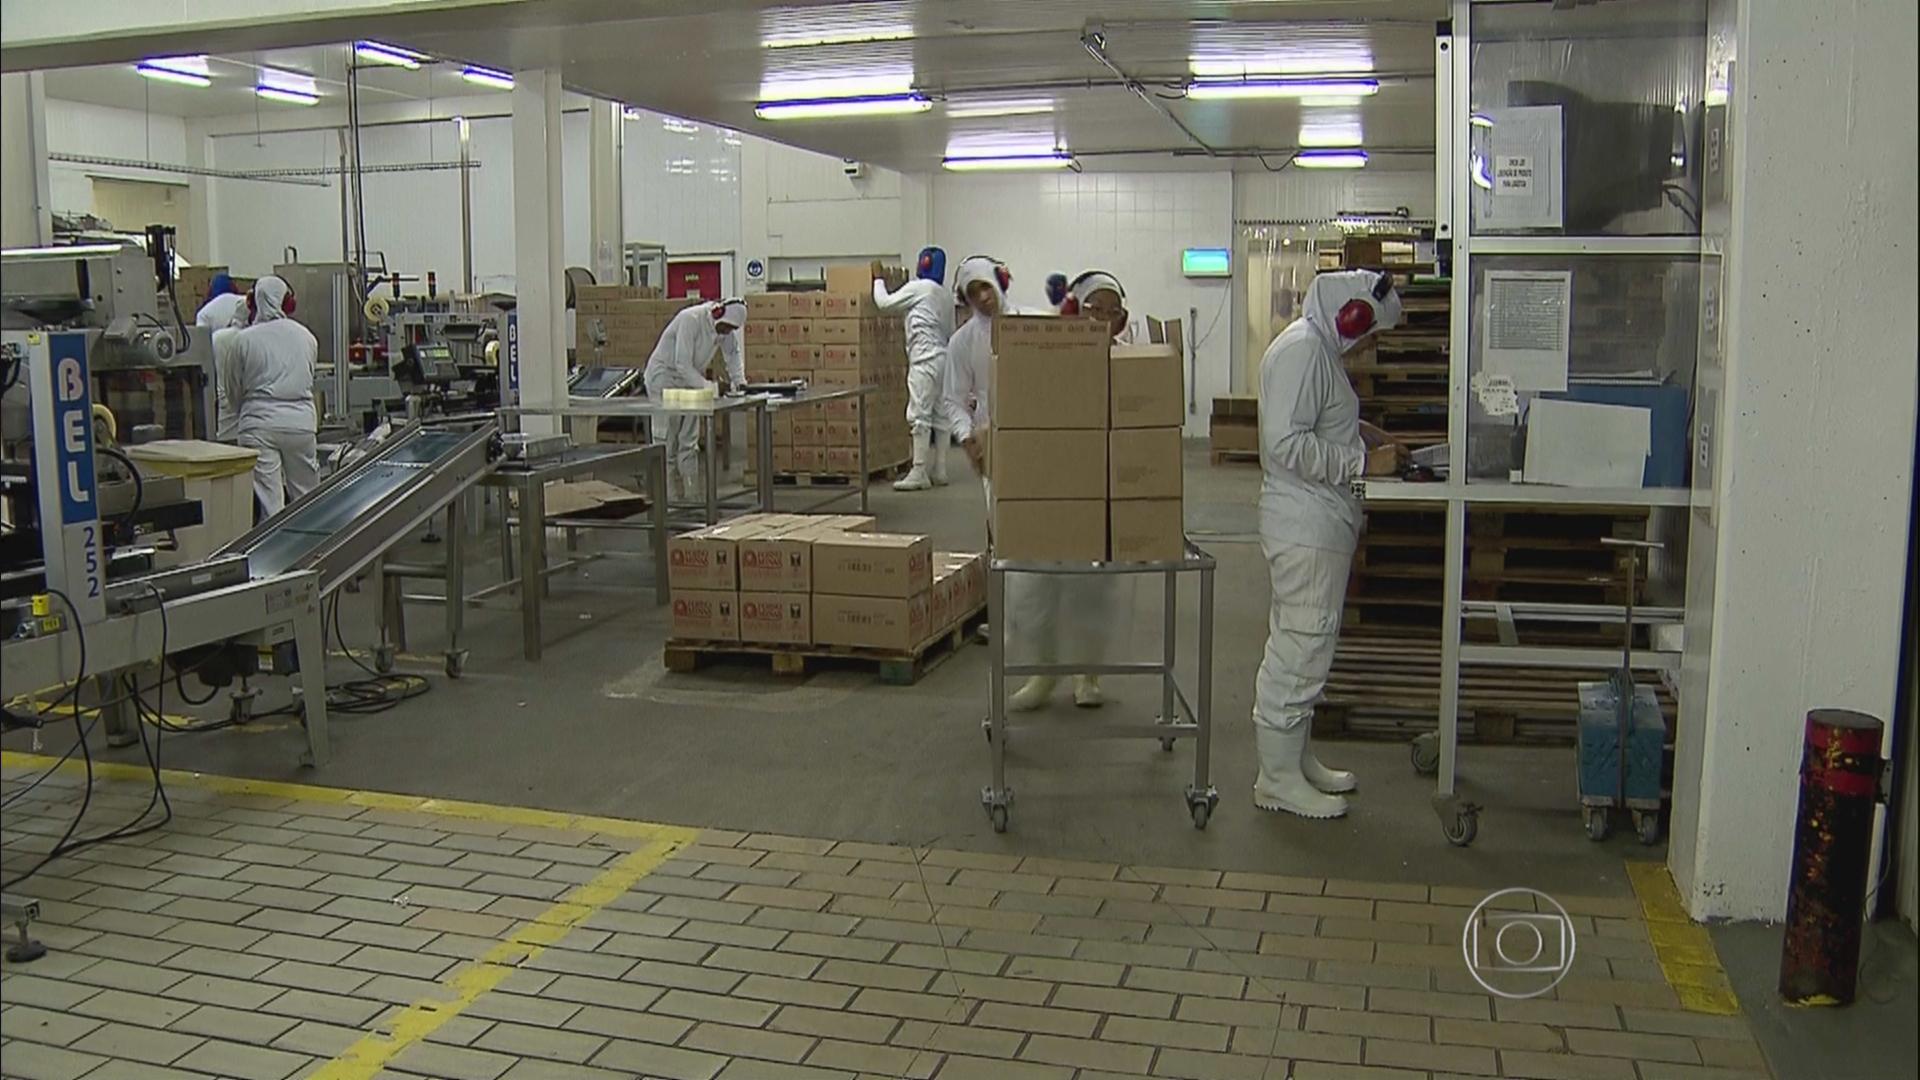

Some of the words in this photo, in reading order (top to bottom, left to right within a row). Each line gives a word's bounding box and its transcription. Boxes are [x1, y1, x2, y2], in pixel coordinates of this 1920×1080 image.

[509, 324, 517, 382] BEL
[58, 357, 89, 502] BEL
[83, 526, 100, 598] 252
